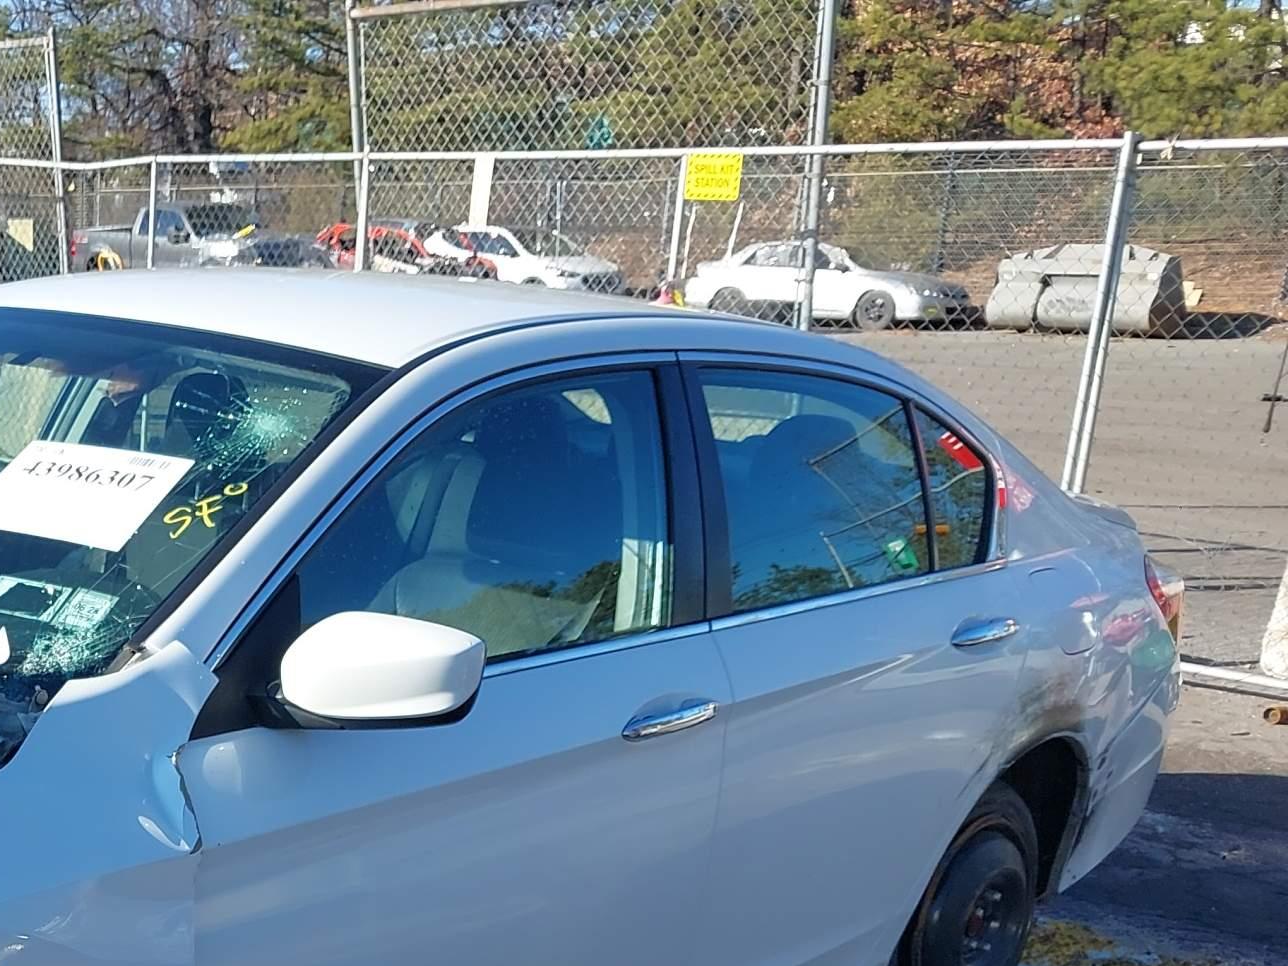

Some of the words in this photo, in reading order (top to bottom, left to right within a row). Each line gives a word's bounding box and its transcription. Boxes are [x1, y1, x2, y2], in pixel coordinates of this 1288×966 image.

[694, 164, 717, 175] SPILL
[719, 164, 734, 175] KIT
[694, 177, 731, 188] STATION
[23, 460, 155, 491] 43986307
